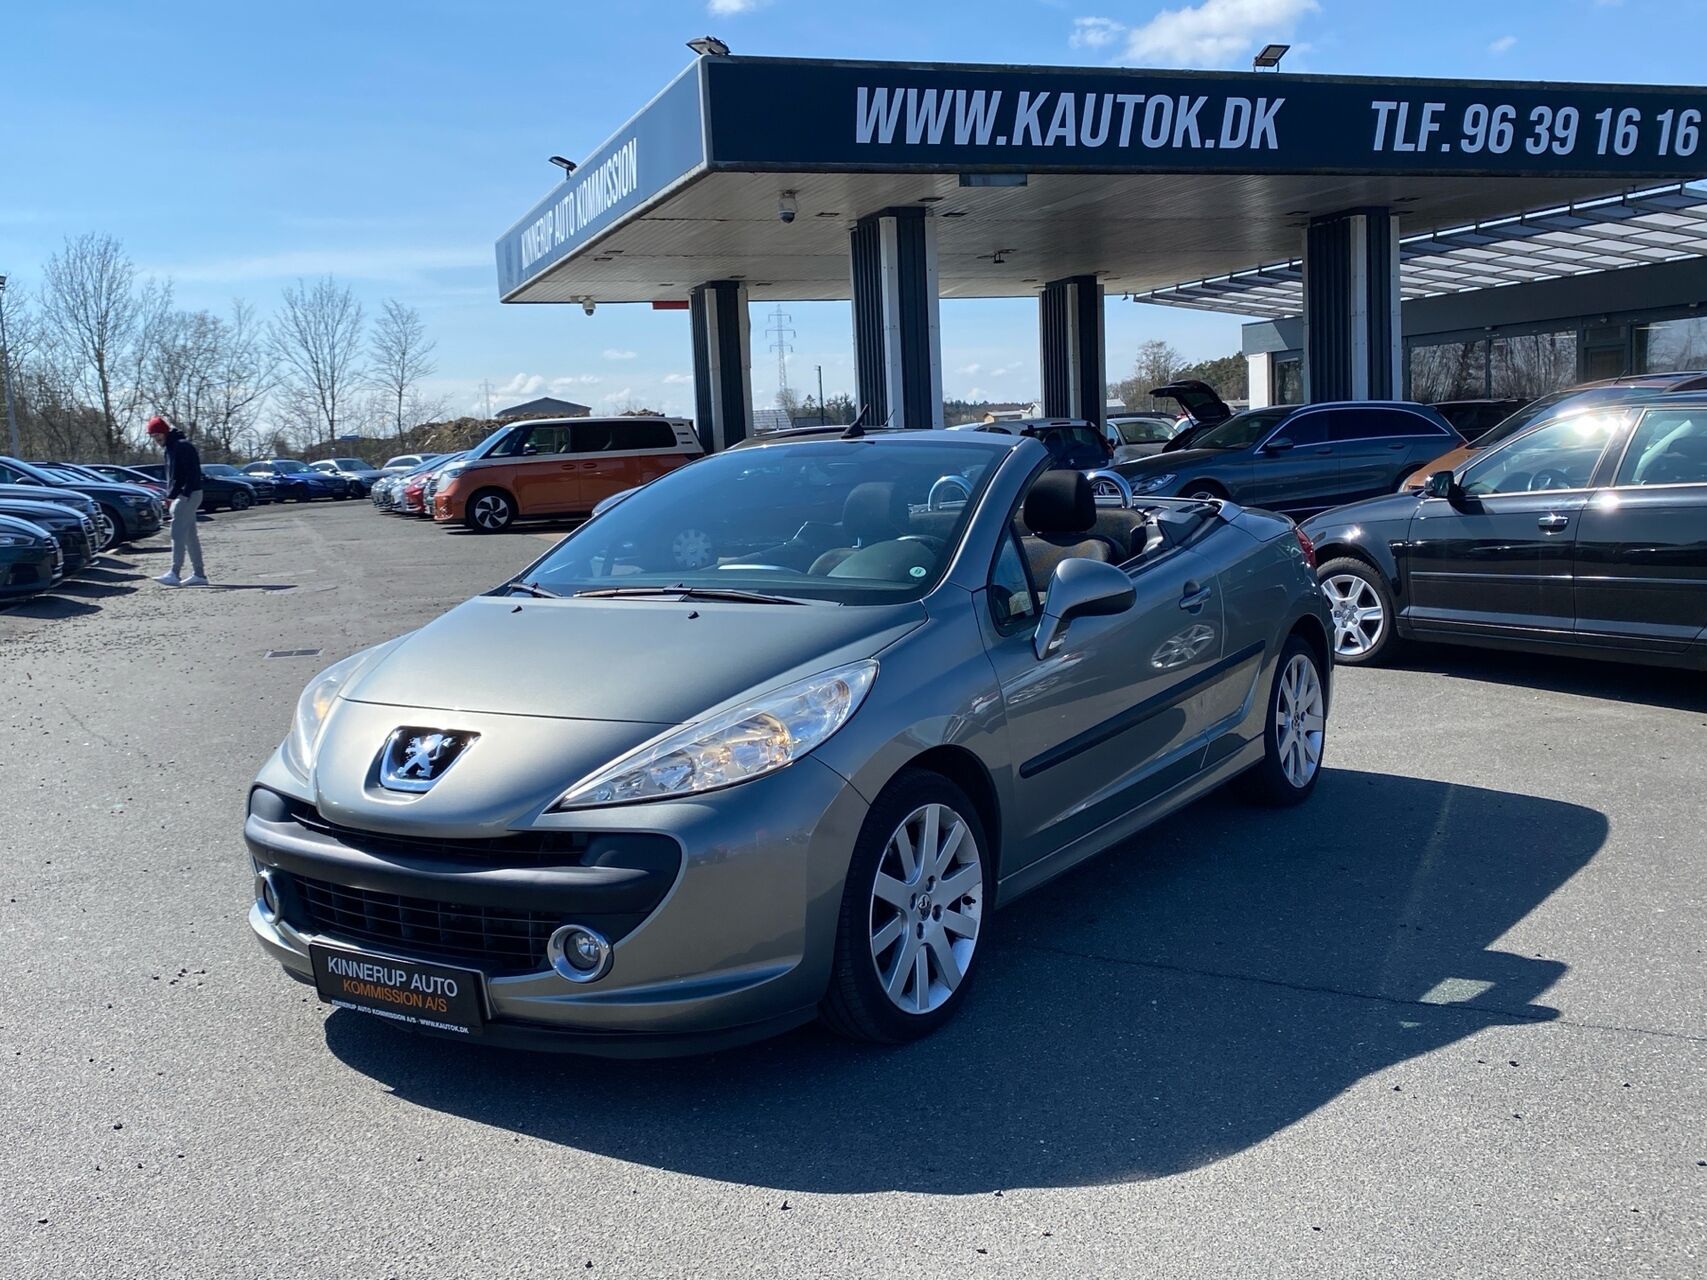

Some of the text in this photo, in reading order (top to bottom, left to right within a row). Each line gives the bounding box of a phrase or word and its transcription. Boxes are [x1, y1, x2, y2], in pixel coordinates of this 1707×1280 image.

[855, 86, 1286, 149] WWW.KAUTOK.DK
[1371, 101, 1702, 156] TLF. 96 39 16 16
[521, 137, 637, 271] KINNERUP AUTO KOMMISSION
[327, 956, 458, 997] KINNERUP AUTO
[343, 979, 448, 1012] KOMMISSION A/S
[357, 1005, 372, 1014] AUTO
